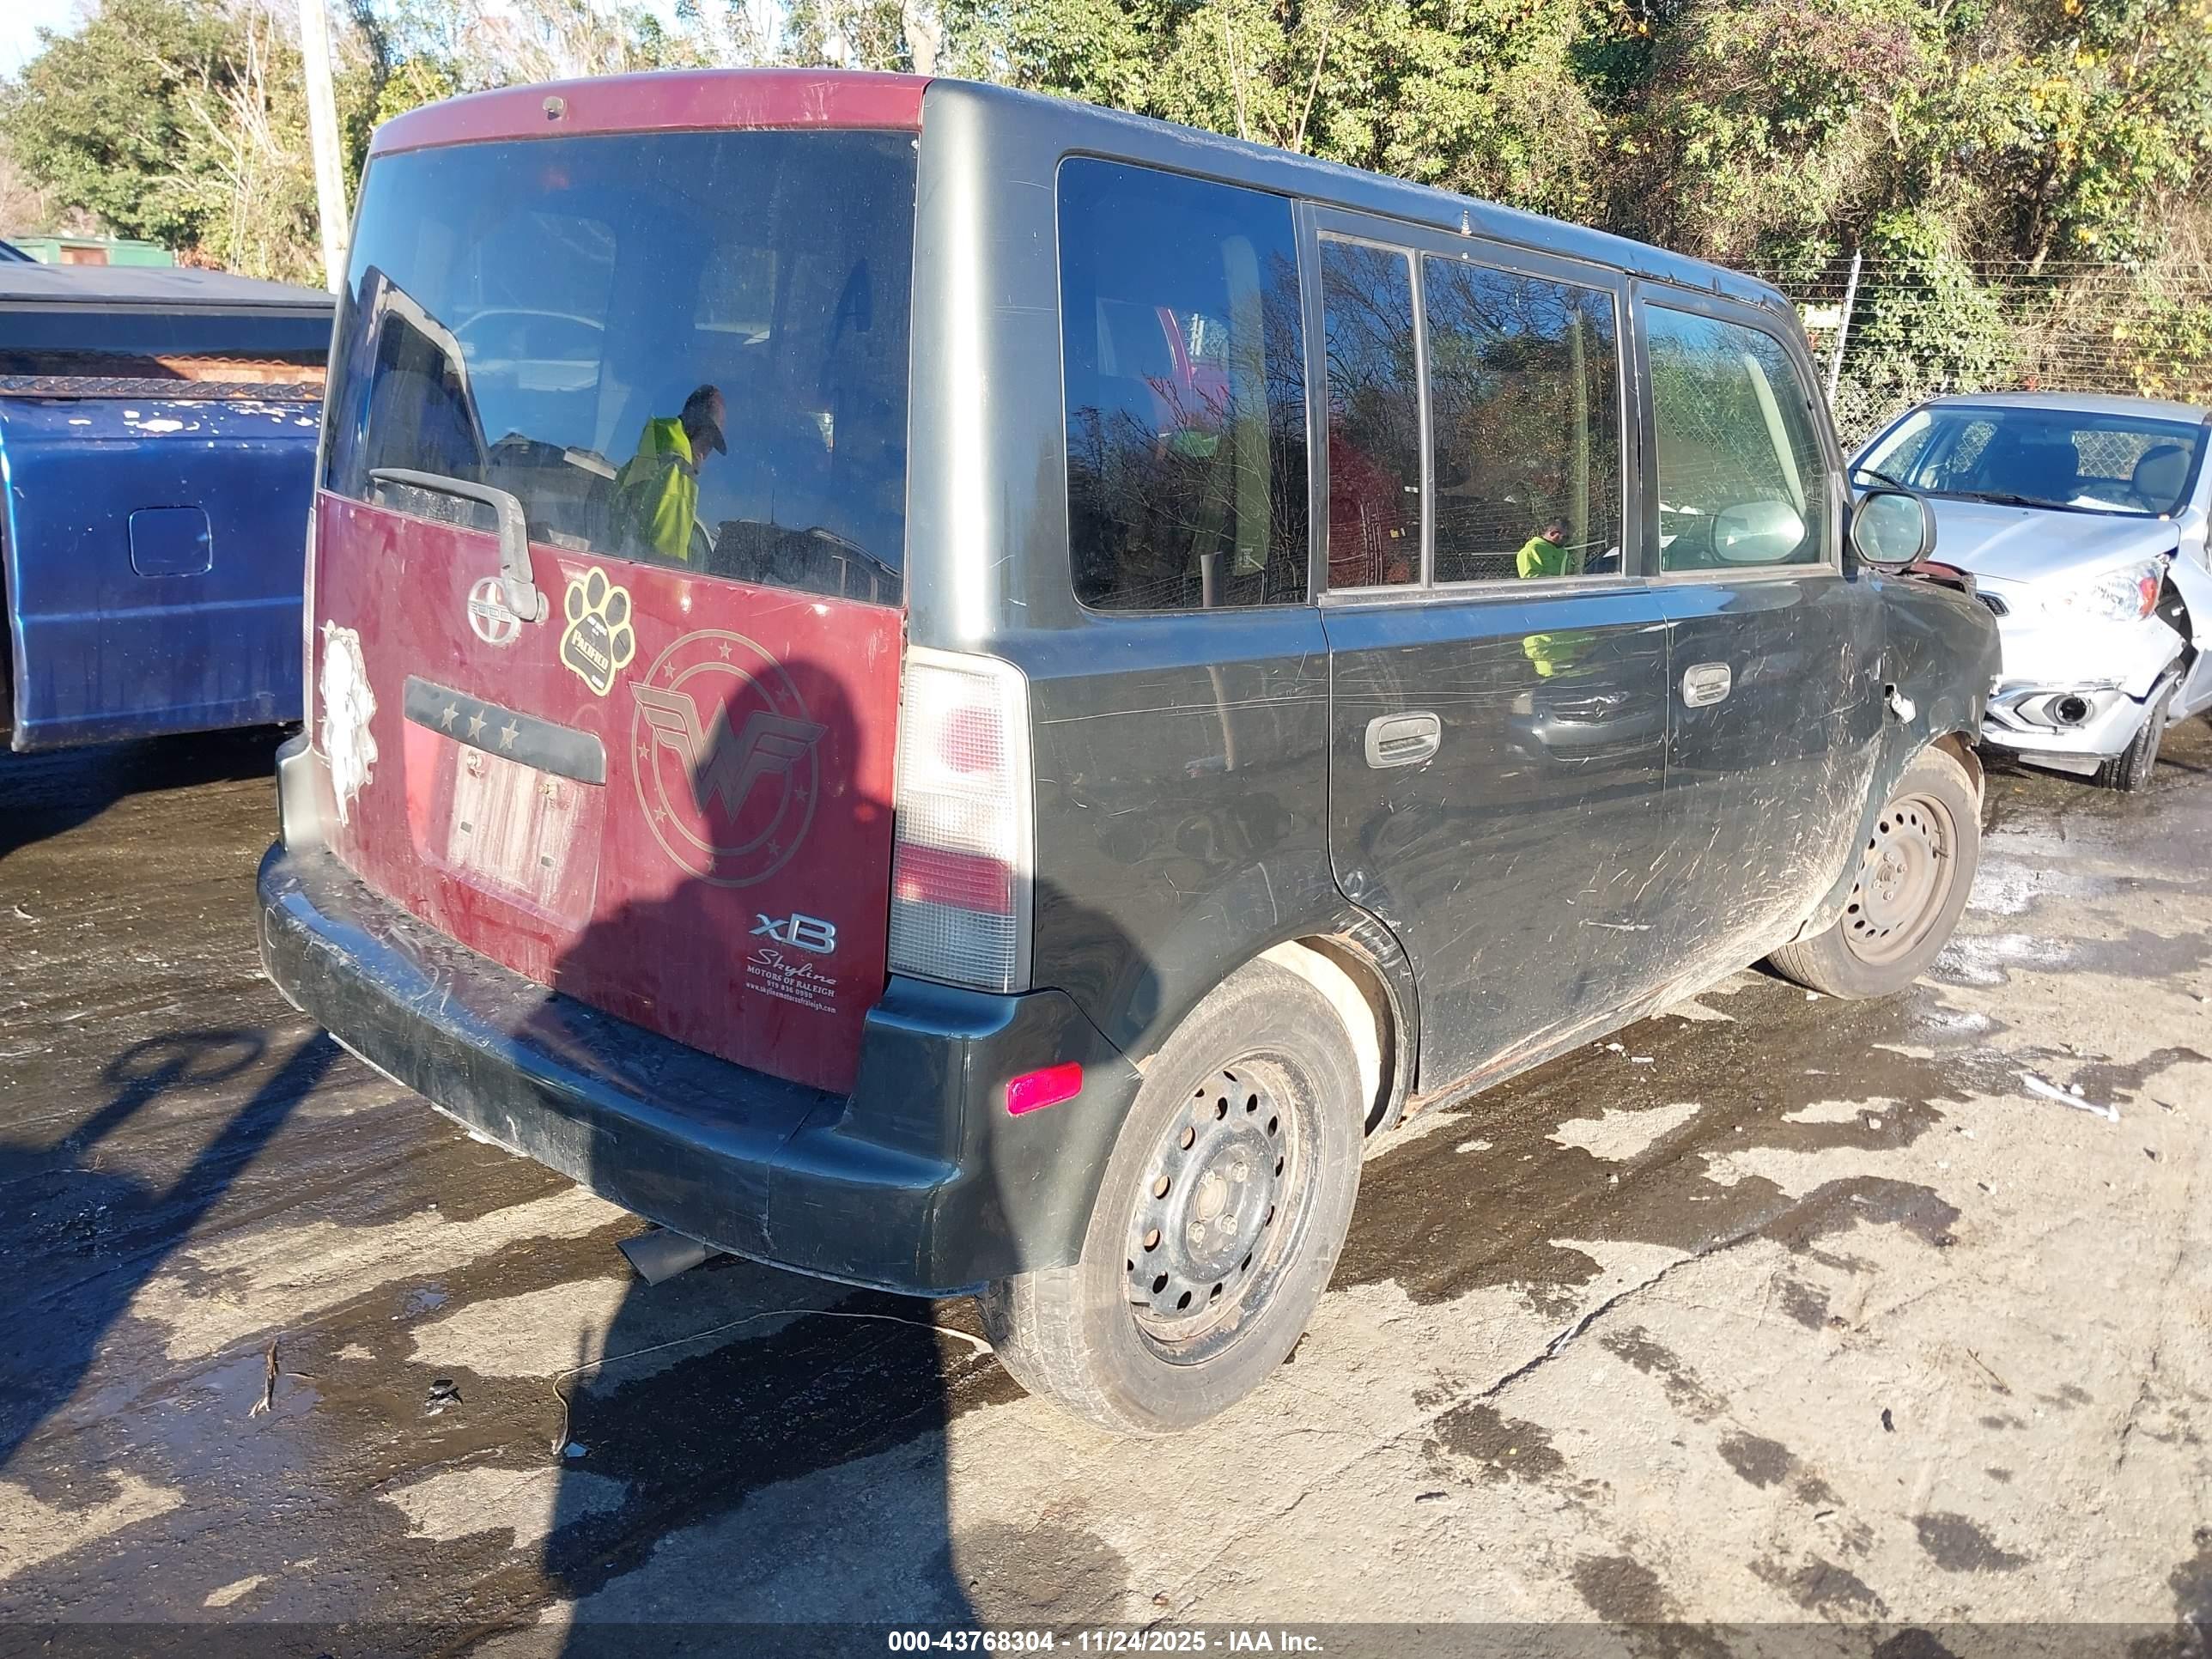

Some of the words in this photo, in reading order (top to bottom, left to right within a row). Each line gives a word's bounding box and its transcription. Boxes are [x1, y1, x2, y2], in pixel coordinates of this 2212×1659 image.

[749, 914, 836, 954] xB
[746, 949, 837, 985] Skyline
[747, 965, 781, 981] MOTORS
[783, 977, 795, 987] OF
[796, 980, 836, 998] RALEIGH
